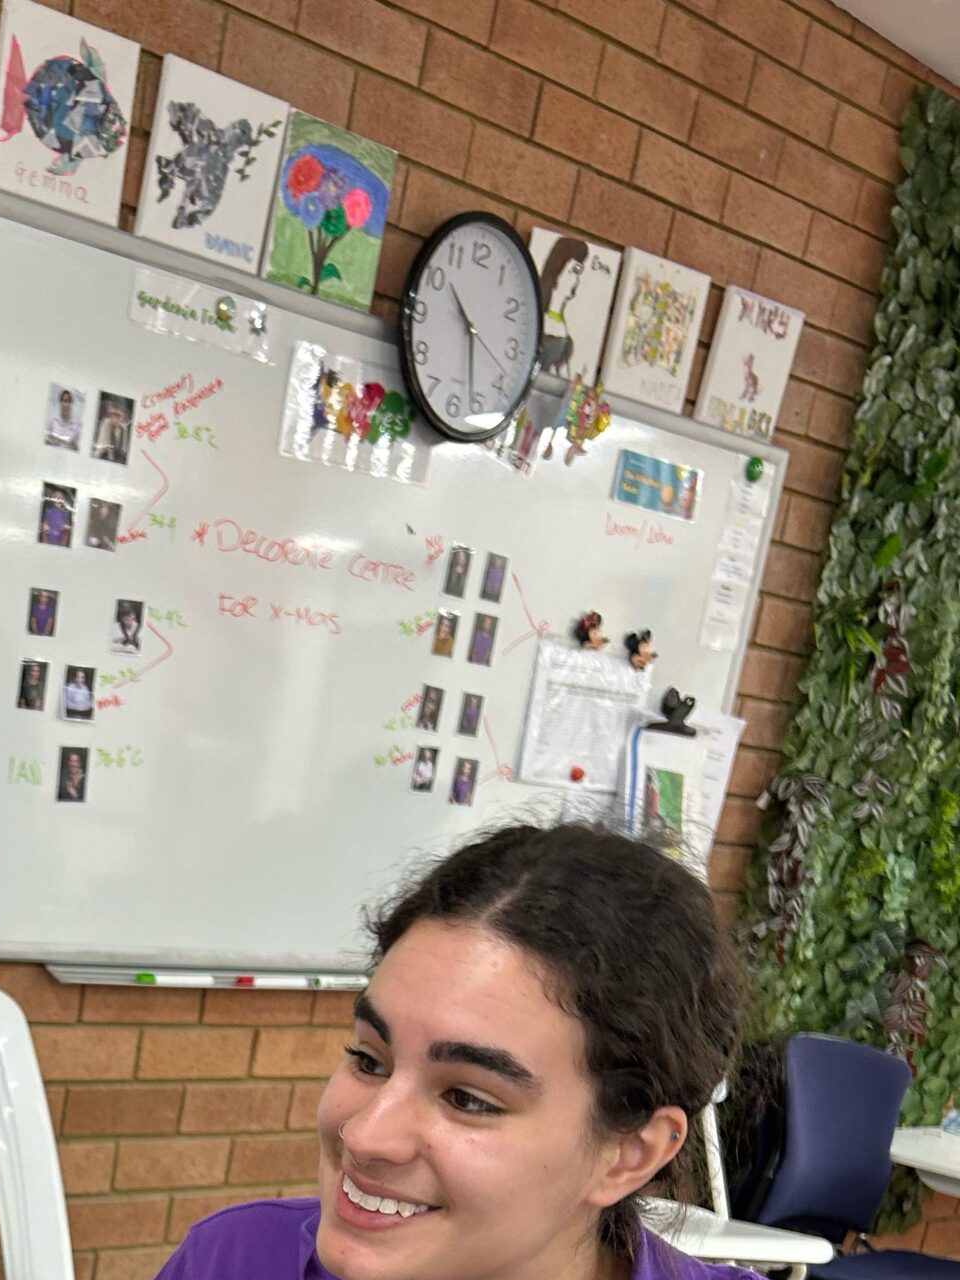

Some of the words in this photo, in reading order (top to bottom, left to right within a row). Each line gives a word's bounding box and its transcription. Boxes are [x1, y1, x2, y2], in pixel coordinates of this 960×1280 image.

[449, 242, 465, 270] 11
[472, 242, 493, 270] 12
[426, 263, 446, 292] 10
[497, 263, 506, 287] 1
[412, 300, 428, 325] 9
[503, 297, 520, 323] 2
[414, 340, 429, 366] 8
[504, 337, 520, 361] 3
[426, 373, 441, 400] 7
[445, 392, 461, 418] 6
